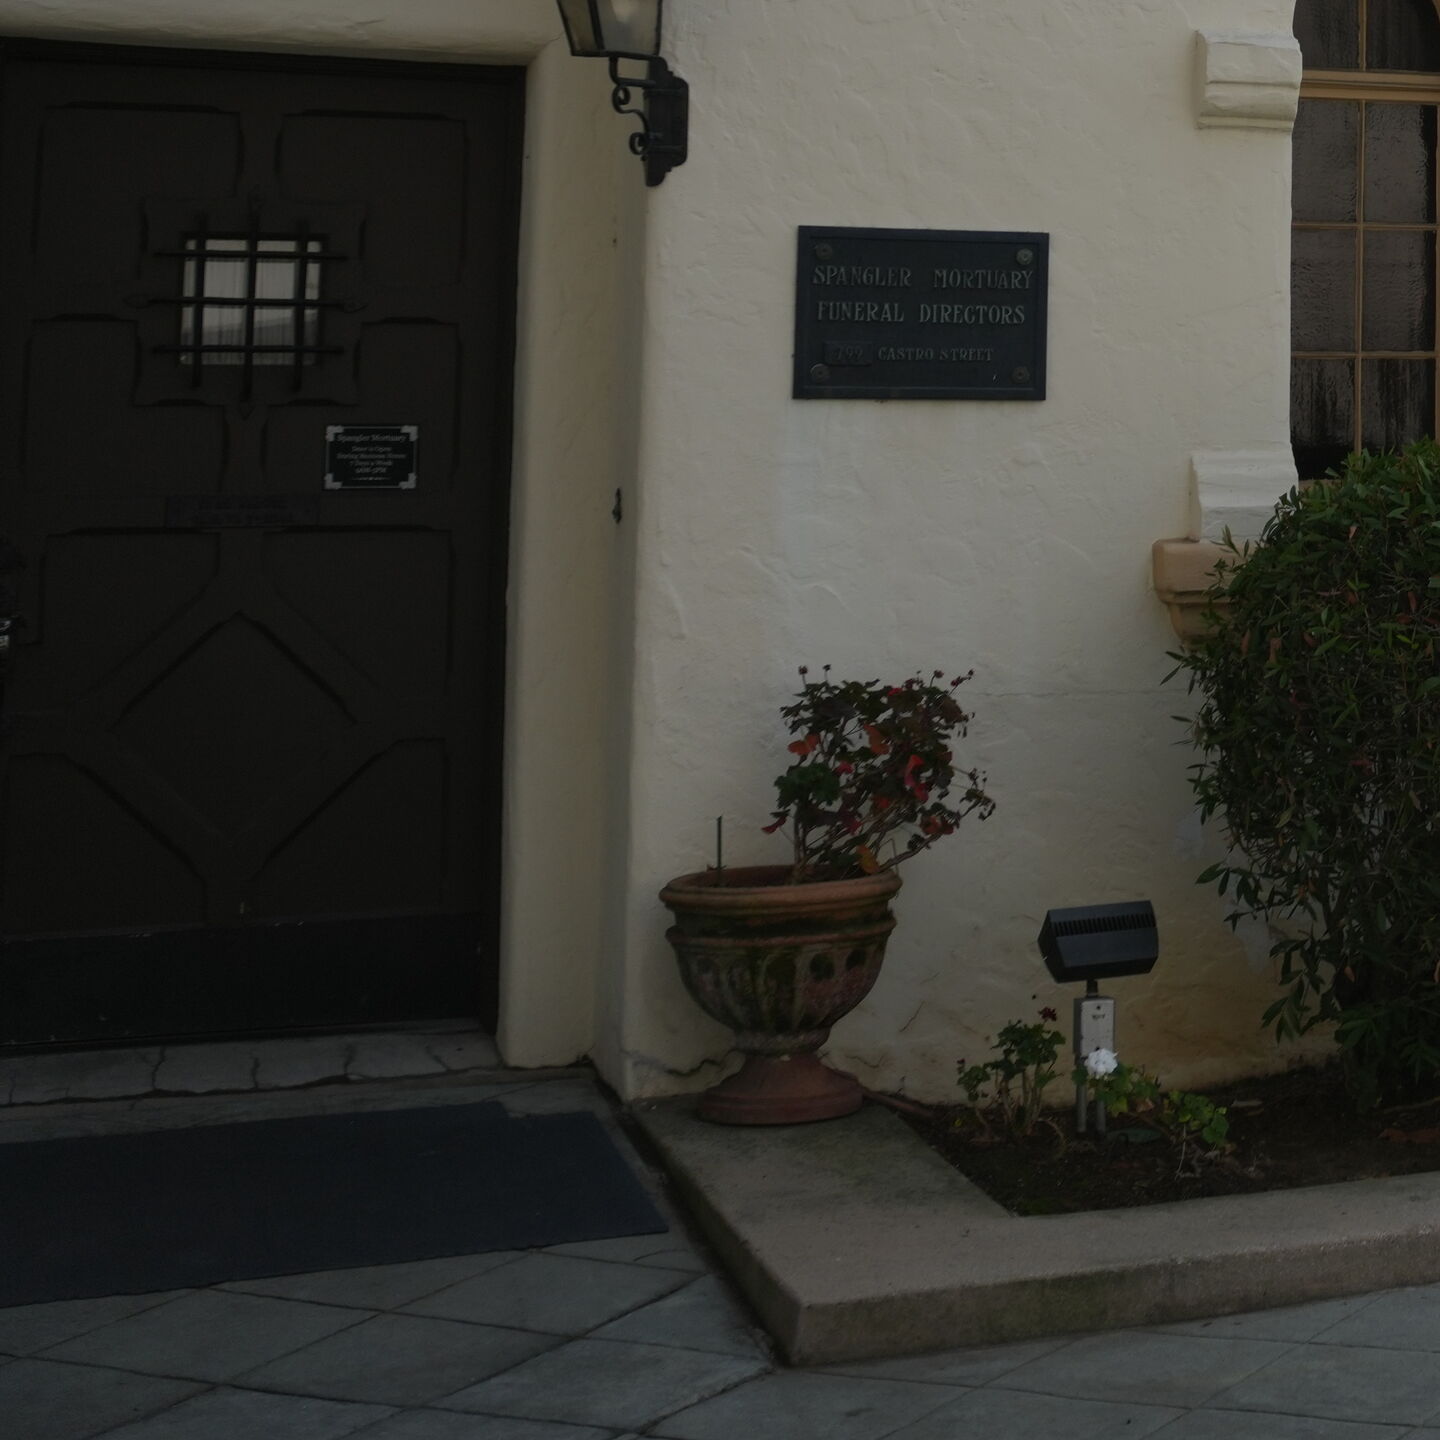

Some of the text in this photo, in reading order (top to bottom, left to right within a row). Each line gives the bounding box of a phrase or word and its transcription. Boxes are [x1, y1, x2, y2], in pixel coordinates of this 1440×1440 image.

[812, 265, 1033, 289] SPANGLER MORTUARY
[817, 301, 1025, 324] FUNERAL DIRECTORS
[878, 346, 934, 361] CASTRO
[940, 348, 994, 362] STREET
